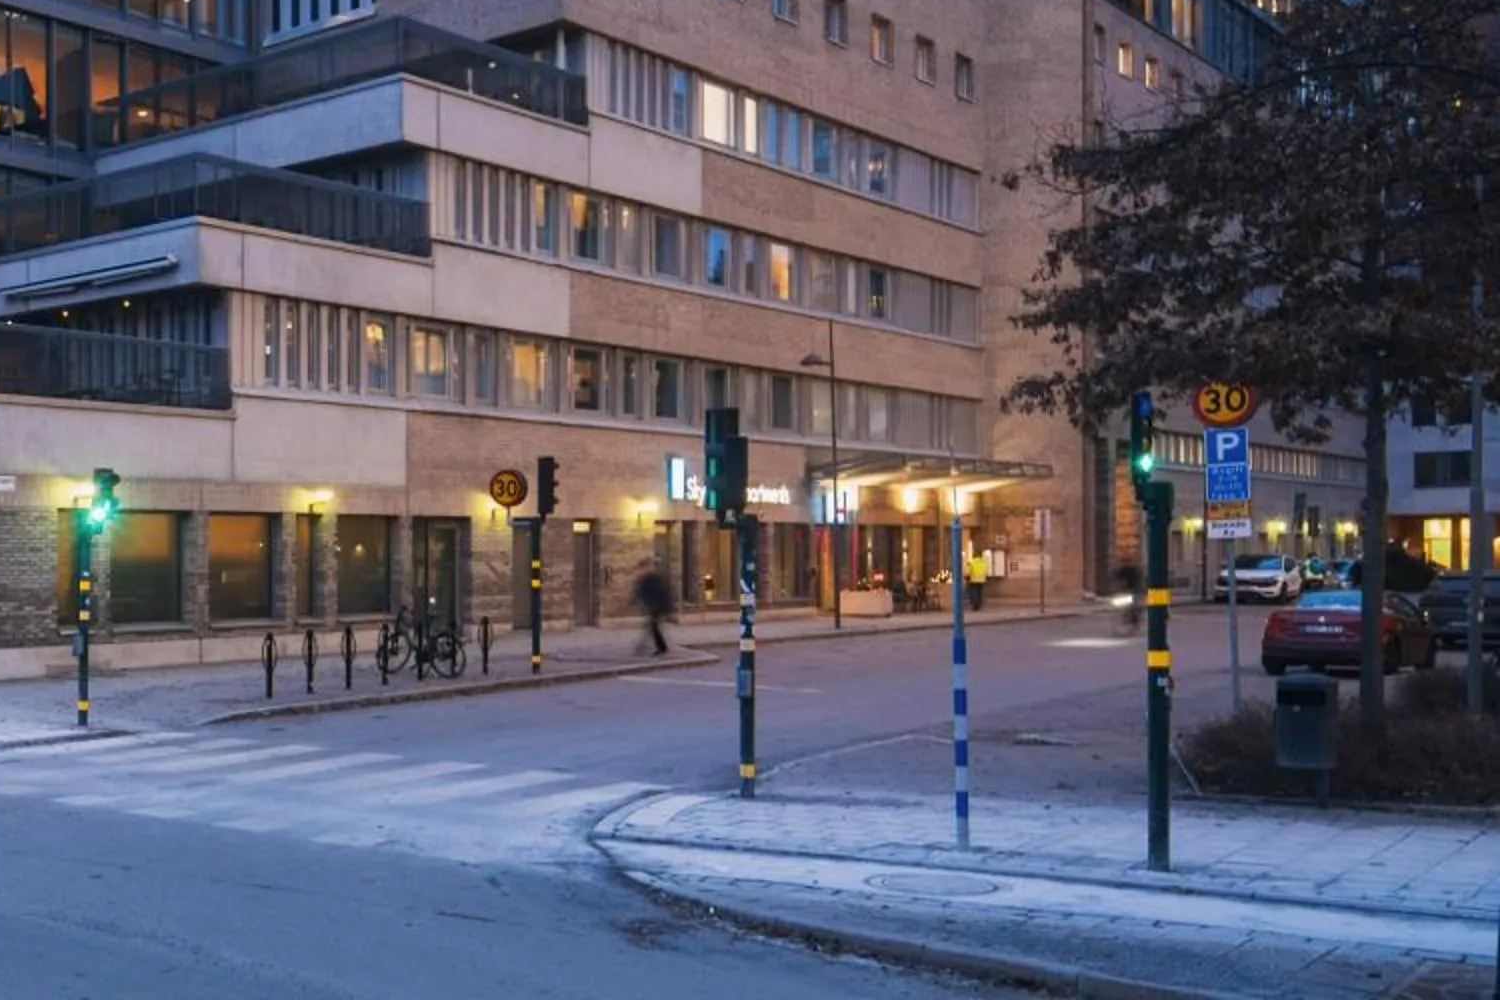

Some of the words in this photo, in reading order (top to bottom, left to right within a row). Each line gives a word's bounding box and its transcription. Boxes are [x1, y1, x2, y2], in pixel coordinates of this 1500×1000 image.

[1204, 388, 1247, 413] 30
[1216, 432, 1240, 461] P
[496, 479, 518, 497] 30
[686, 475, 706, 507] Sky
